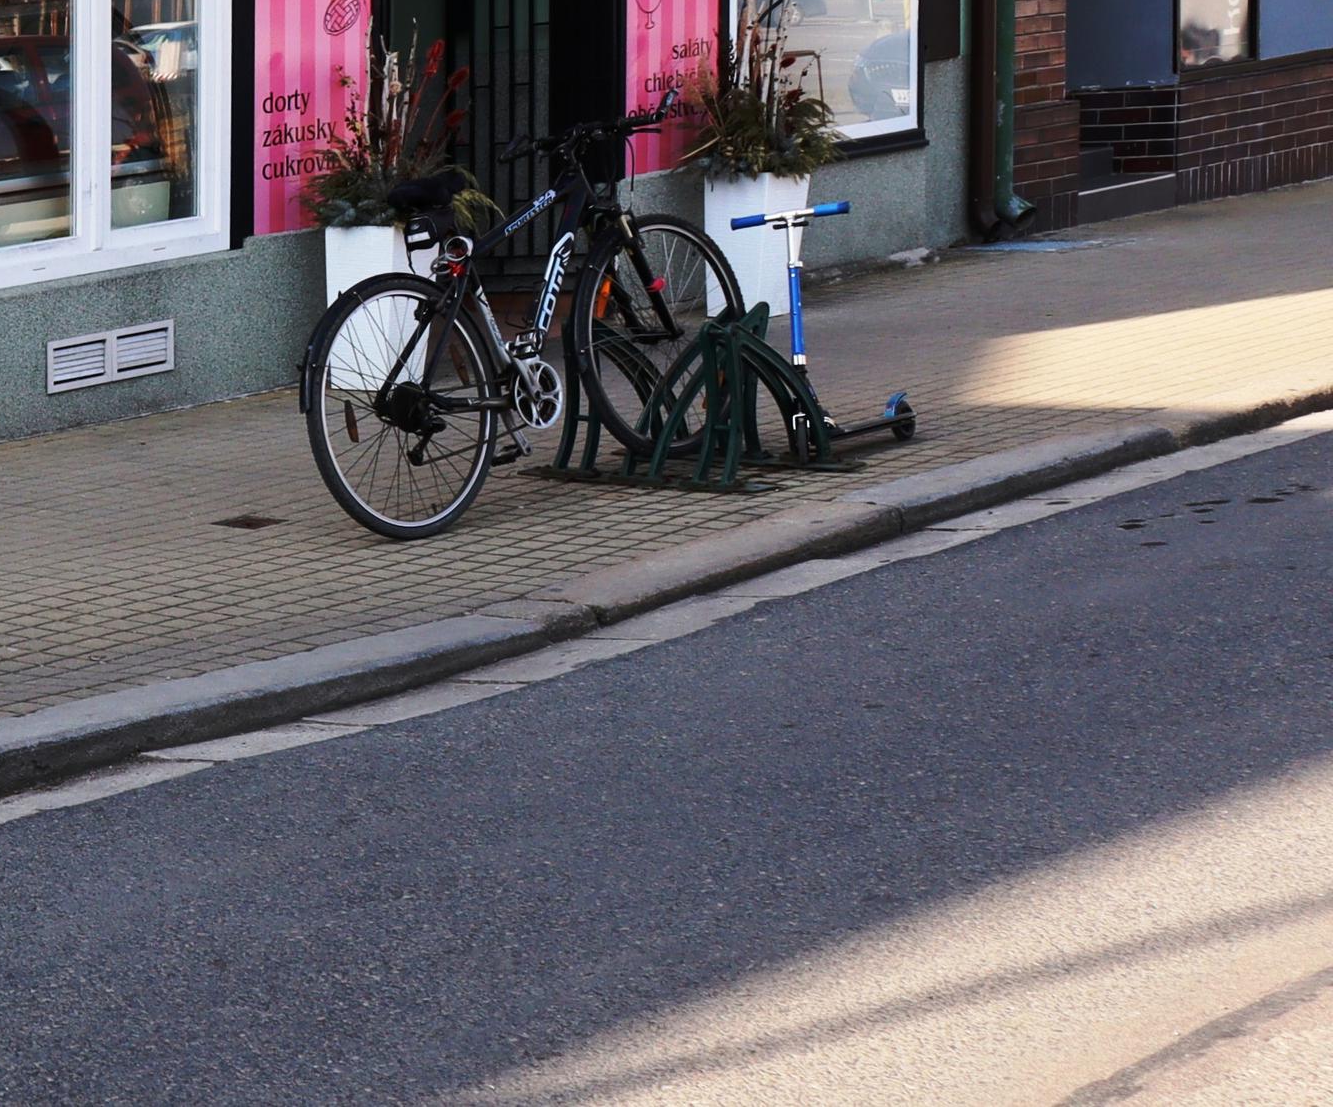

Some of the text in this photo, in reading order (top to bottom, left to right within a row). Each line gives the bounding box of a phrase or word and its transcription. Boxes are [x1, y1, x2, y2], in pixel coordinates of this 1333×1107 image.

[672, 38, 713, 60] saláty
[262, 89, 311, 115] dorty
[262, 118, 337, 147] zákusky
